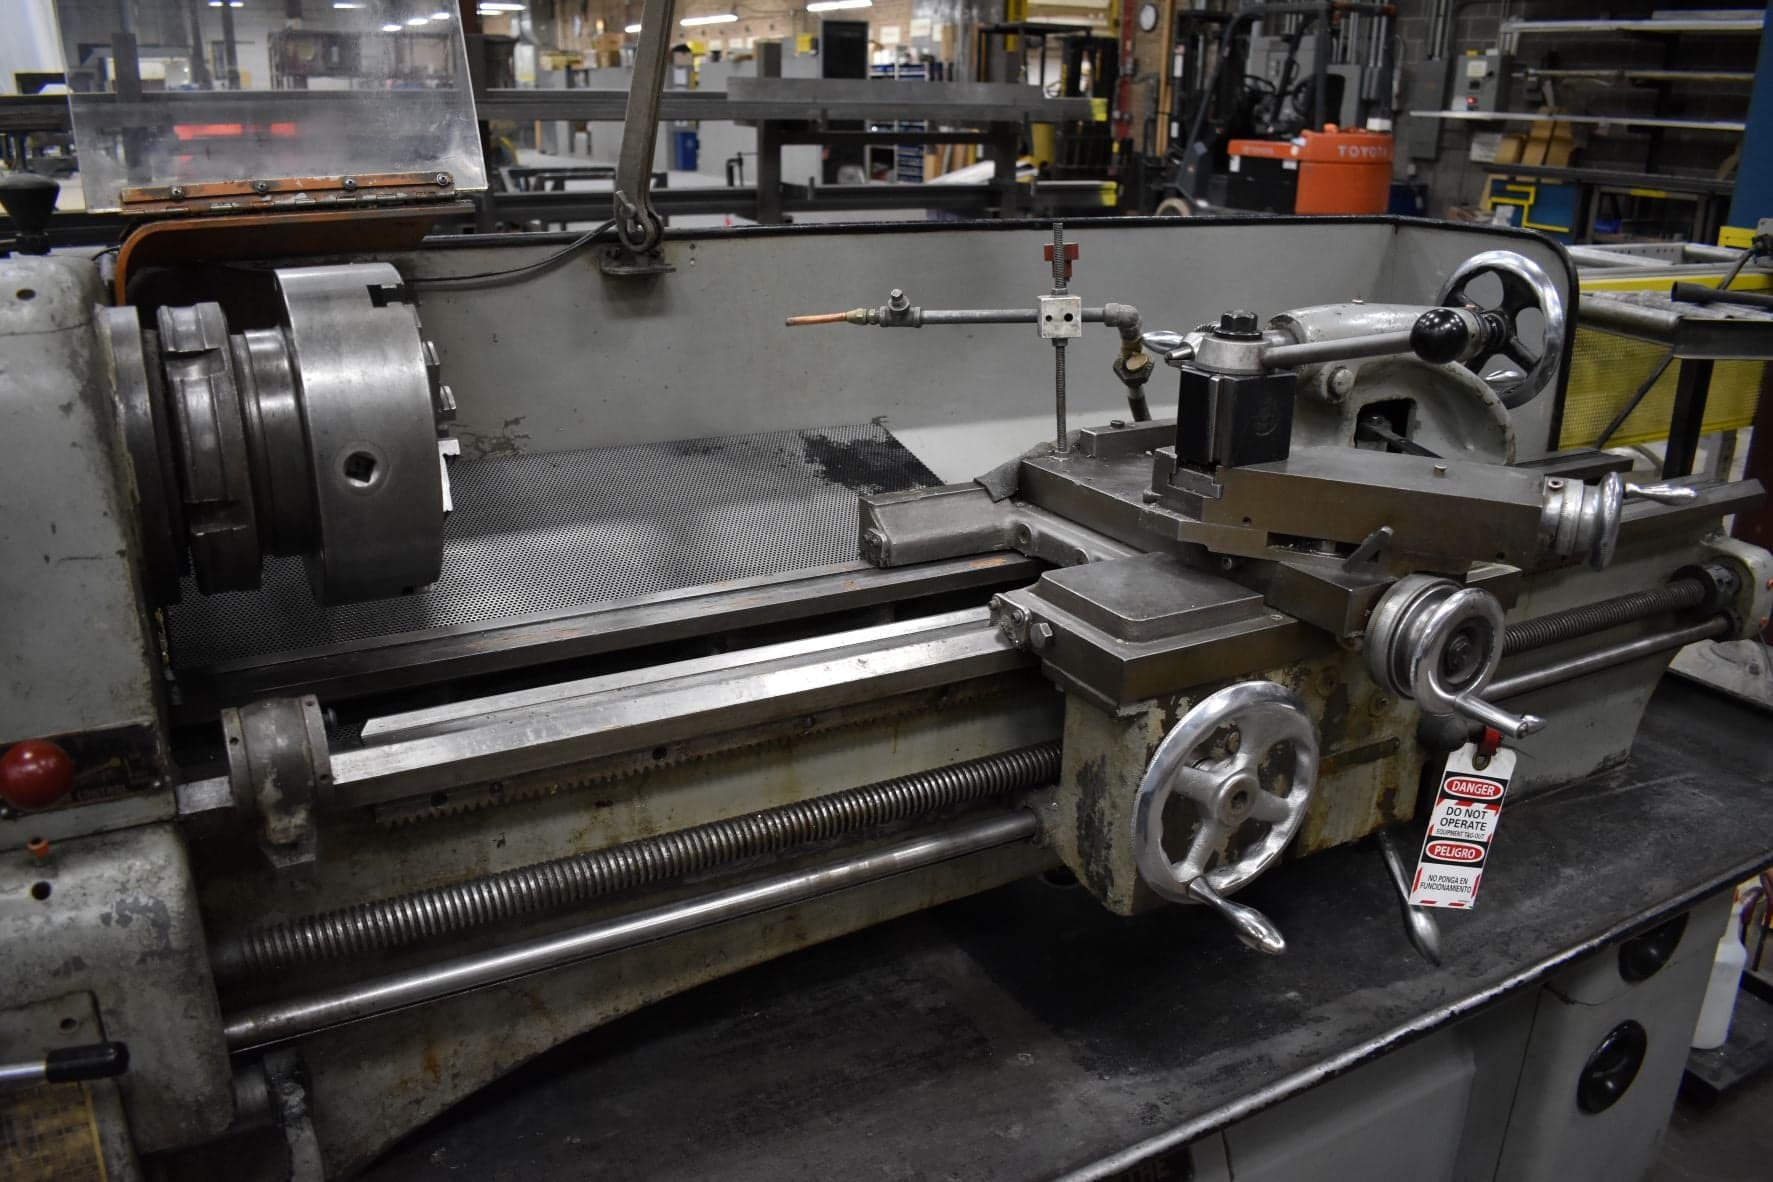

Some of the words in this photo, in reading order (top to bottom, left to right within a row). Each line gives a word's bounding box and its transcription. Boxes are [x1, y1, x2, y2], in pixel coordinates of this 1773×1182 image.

[1451, 780, 1495, 797] DANGER
[1446, 806, 1462, 817] DO
[1464, 808, 1488, 820] NOT
[1440, 817, 1488, 832] OPERATE
[1436, 828, 1463, 838] EQUIPMENT
[1434, 845, 1476, 859] PELIGRO
[1428, 874, 1438, 882] NO
[1438, 875, 1459, 885] PONGA
[1459, 876, 1469, 885] EN
[1420, 880, 1472, 894] FUNCIONAMIENTO
